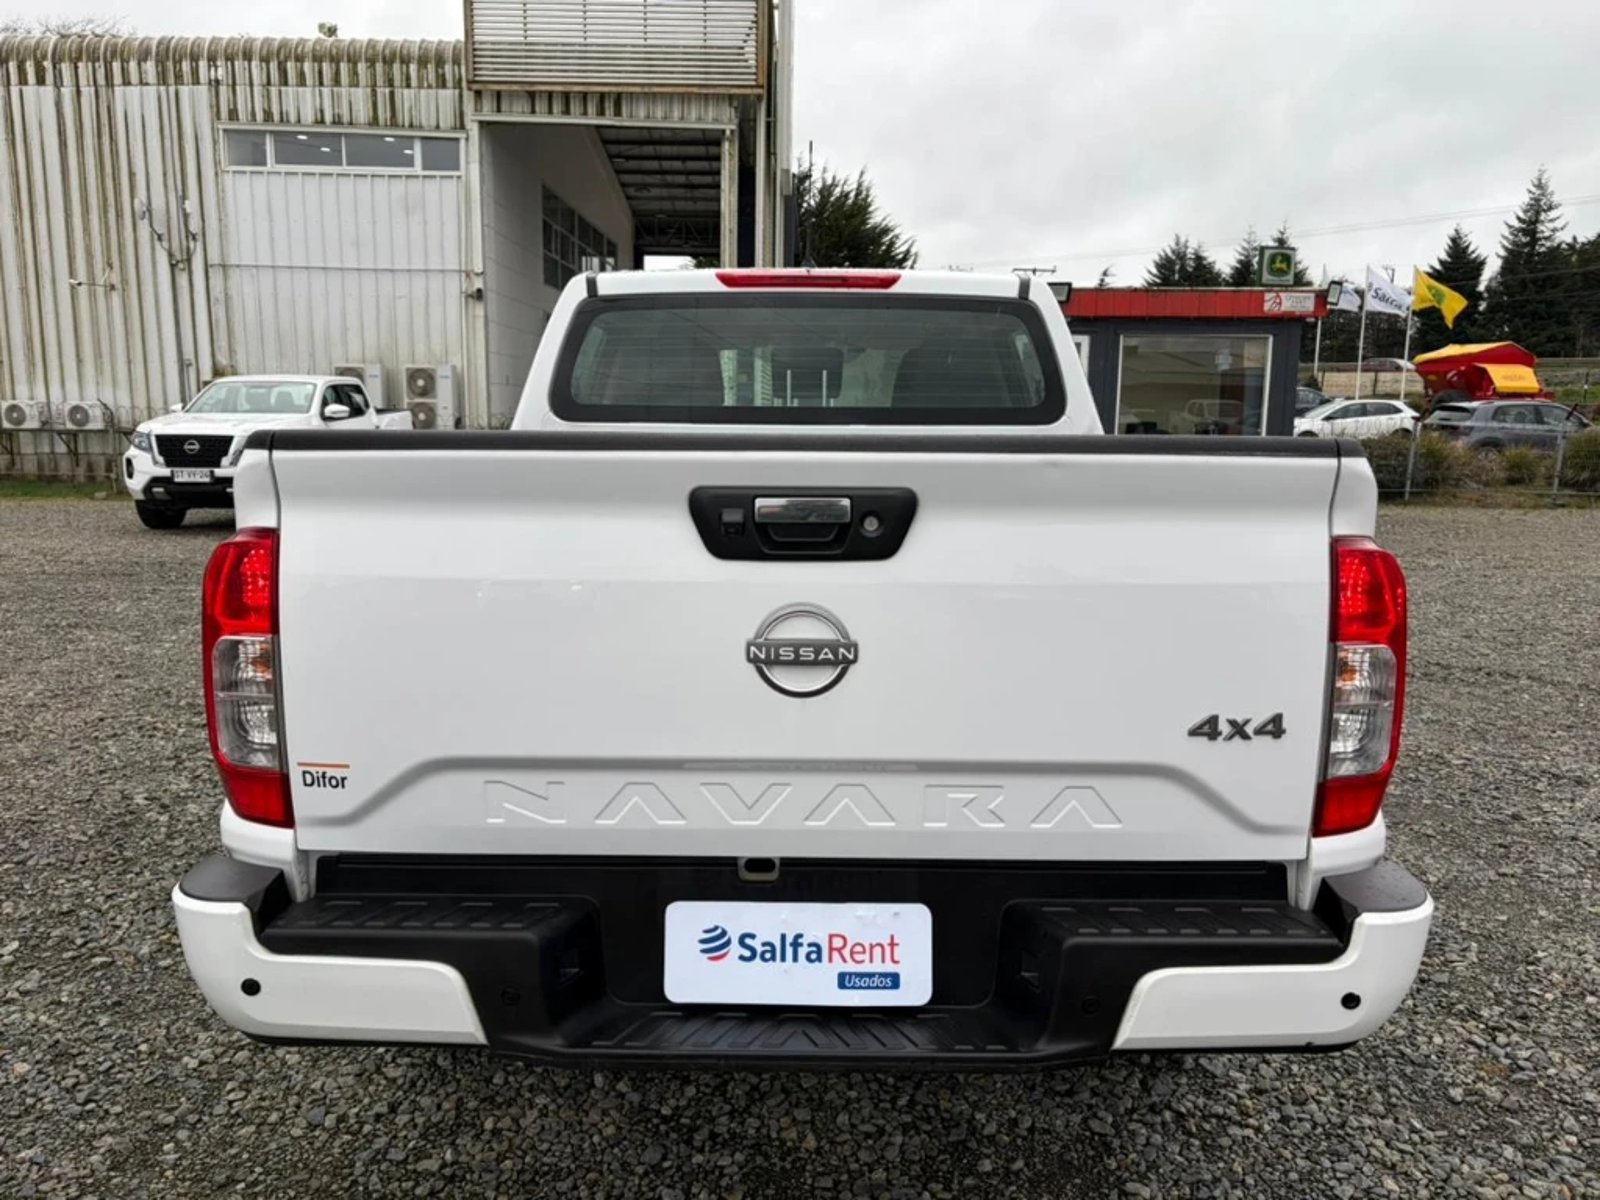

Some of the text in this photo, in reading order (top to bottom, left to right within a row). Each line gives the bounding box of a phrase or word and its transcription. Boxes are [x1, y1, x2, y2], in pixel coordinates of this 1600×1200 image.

[749, 645, 855, 661] NISSAN
[1187, 712, 1287, 741] 4x4
[301, 769, 348, 790] Difor
[483, 779, 1123, 828] NAVARA
[737, 932, 901, 965] SalfaRent
[844, 974, 893, 988] Usados
